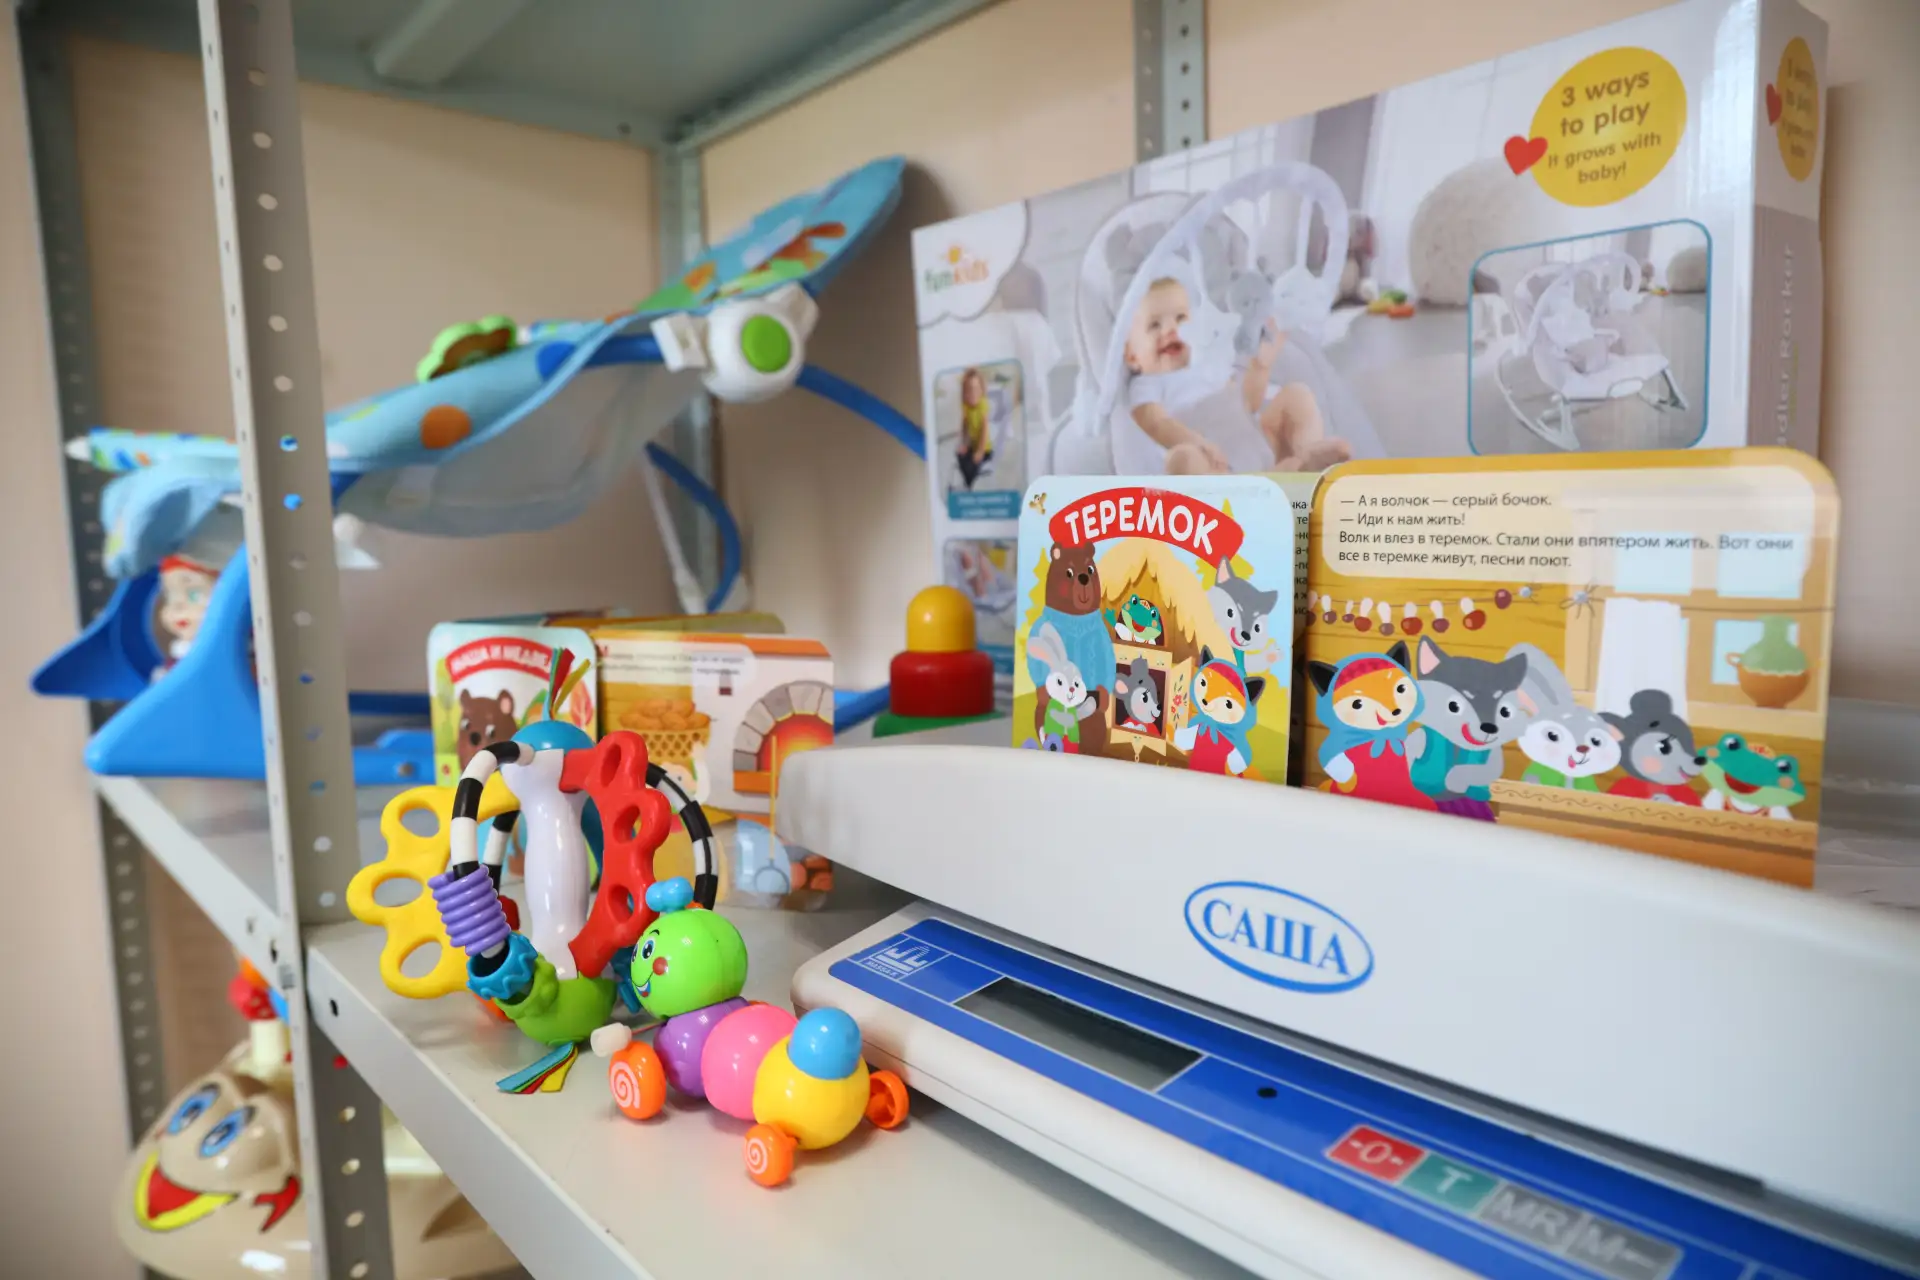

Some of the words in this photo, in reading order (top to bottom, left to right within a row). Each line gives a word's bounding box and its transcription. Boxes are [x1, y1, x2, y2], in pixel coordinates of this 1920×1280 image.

[1560, 86, 1575, 108] 3
[1584, 71, 1651, 102] ways
[1560, 117, 1584, 138] to
[1593, 101, 1651, 136] play
[1564, 143, 1616, 169] grows
[1621, 132, 1662, 153] with
[1577, 161, 1627, 185] baby!
[1358, 495, 1367, 506] А
[1370, 497, 1377, 506] я
[1381, 496, 1430, 507] волчок
[1452, 493, 1498, 508] серый
[1502, 493, 1552, 506] бочок.
[1064, 497, 1219, 555] ТЕРЕМОК
[1357, 513, 1383, 526] Иди
[1387, 515, 1394, 525] к
[1397, 515, 1424, 525] нам
[1427, 513, 1466, 525] жить!
[1339, 531, 1370, 543] Волк
[1373, 534, 1381, 543] и
[1384, 534, 1414, 544] влез
[1418, 534, 1425, 544] в
[1430, 534, 1491, 547] теремок.
[1496, 532, 1540, 546] Стали
[1544, 535, 1574, 547] они
[1578, 536, 1660, 550] впятером
[1664, 537, 1715, 549] жить.
[1717, 534, 1750, 550] Вот
[1756, 538, 1794, 550] они
[1339, 551, 1360, 562] все
[1363, 552, 1370, 562] в
[1374, 553, 1428, 563] теремке
[1432, 553, 1477, 567] живут,
[1481, 554, 1525, 566] песни
[1529, 556, 1572, 567] поют.
[1203, 898, 1352, 976] САША
[1436, 1165, 1473, 1194] T
[1493, 1192, 1570, 1238] MR
